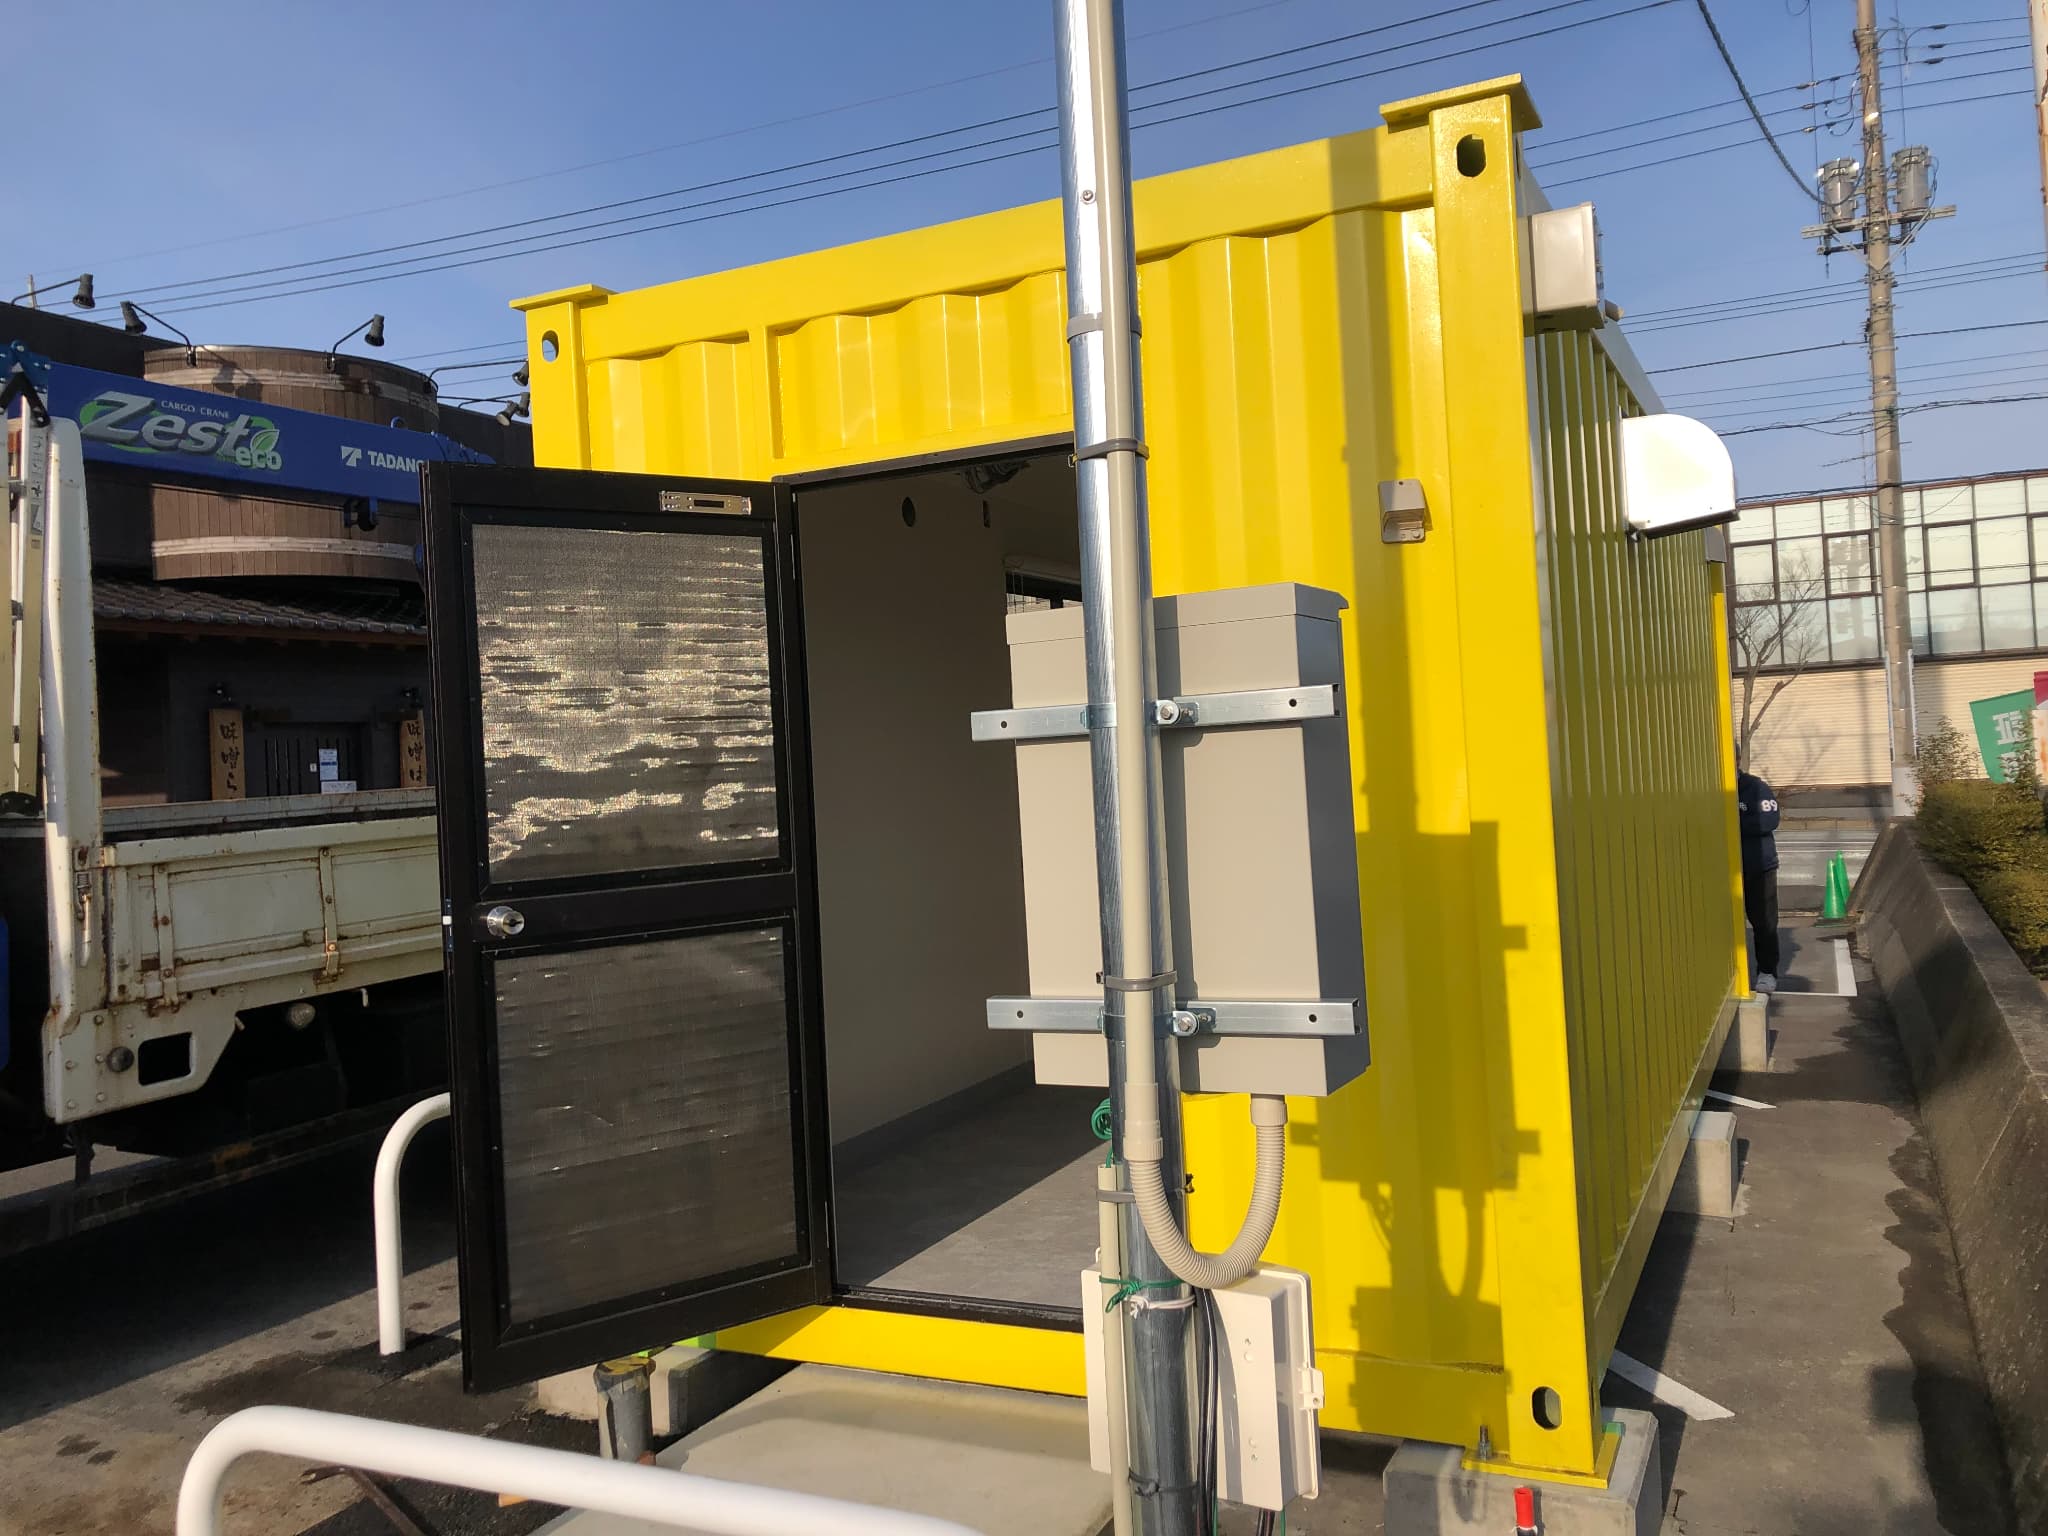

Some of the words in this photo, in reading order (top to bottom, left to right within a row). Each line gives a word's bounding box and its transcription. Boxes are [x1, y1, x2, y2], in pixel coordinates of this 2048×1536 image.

[161, 400, 196, 414] CARGO
[200, 406, 230, 420] CRANE
[80, 391, 251, 457] Zest
[235, 446, 283, 471] eco
[1761, 799, 1778, 812] 89
